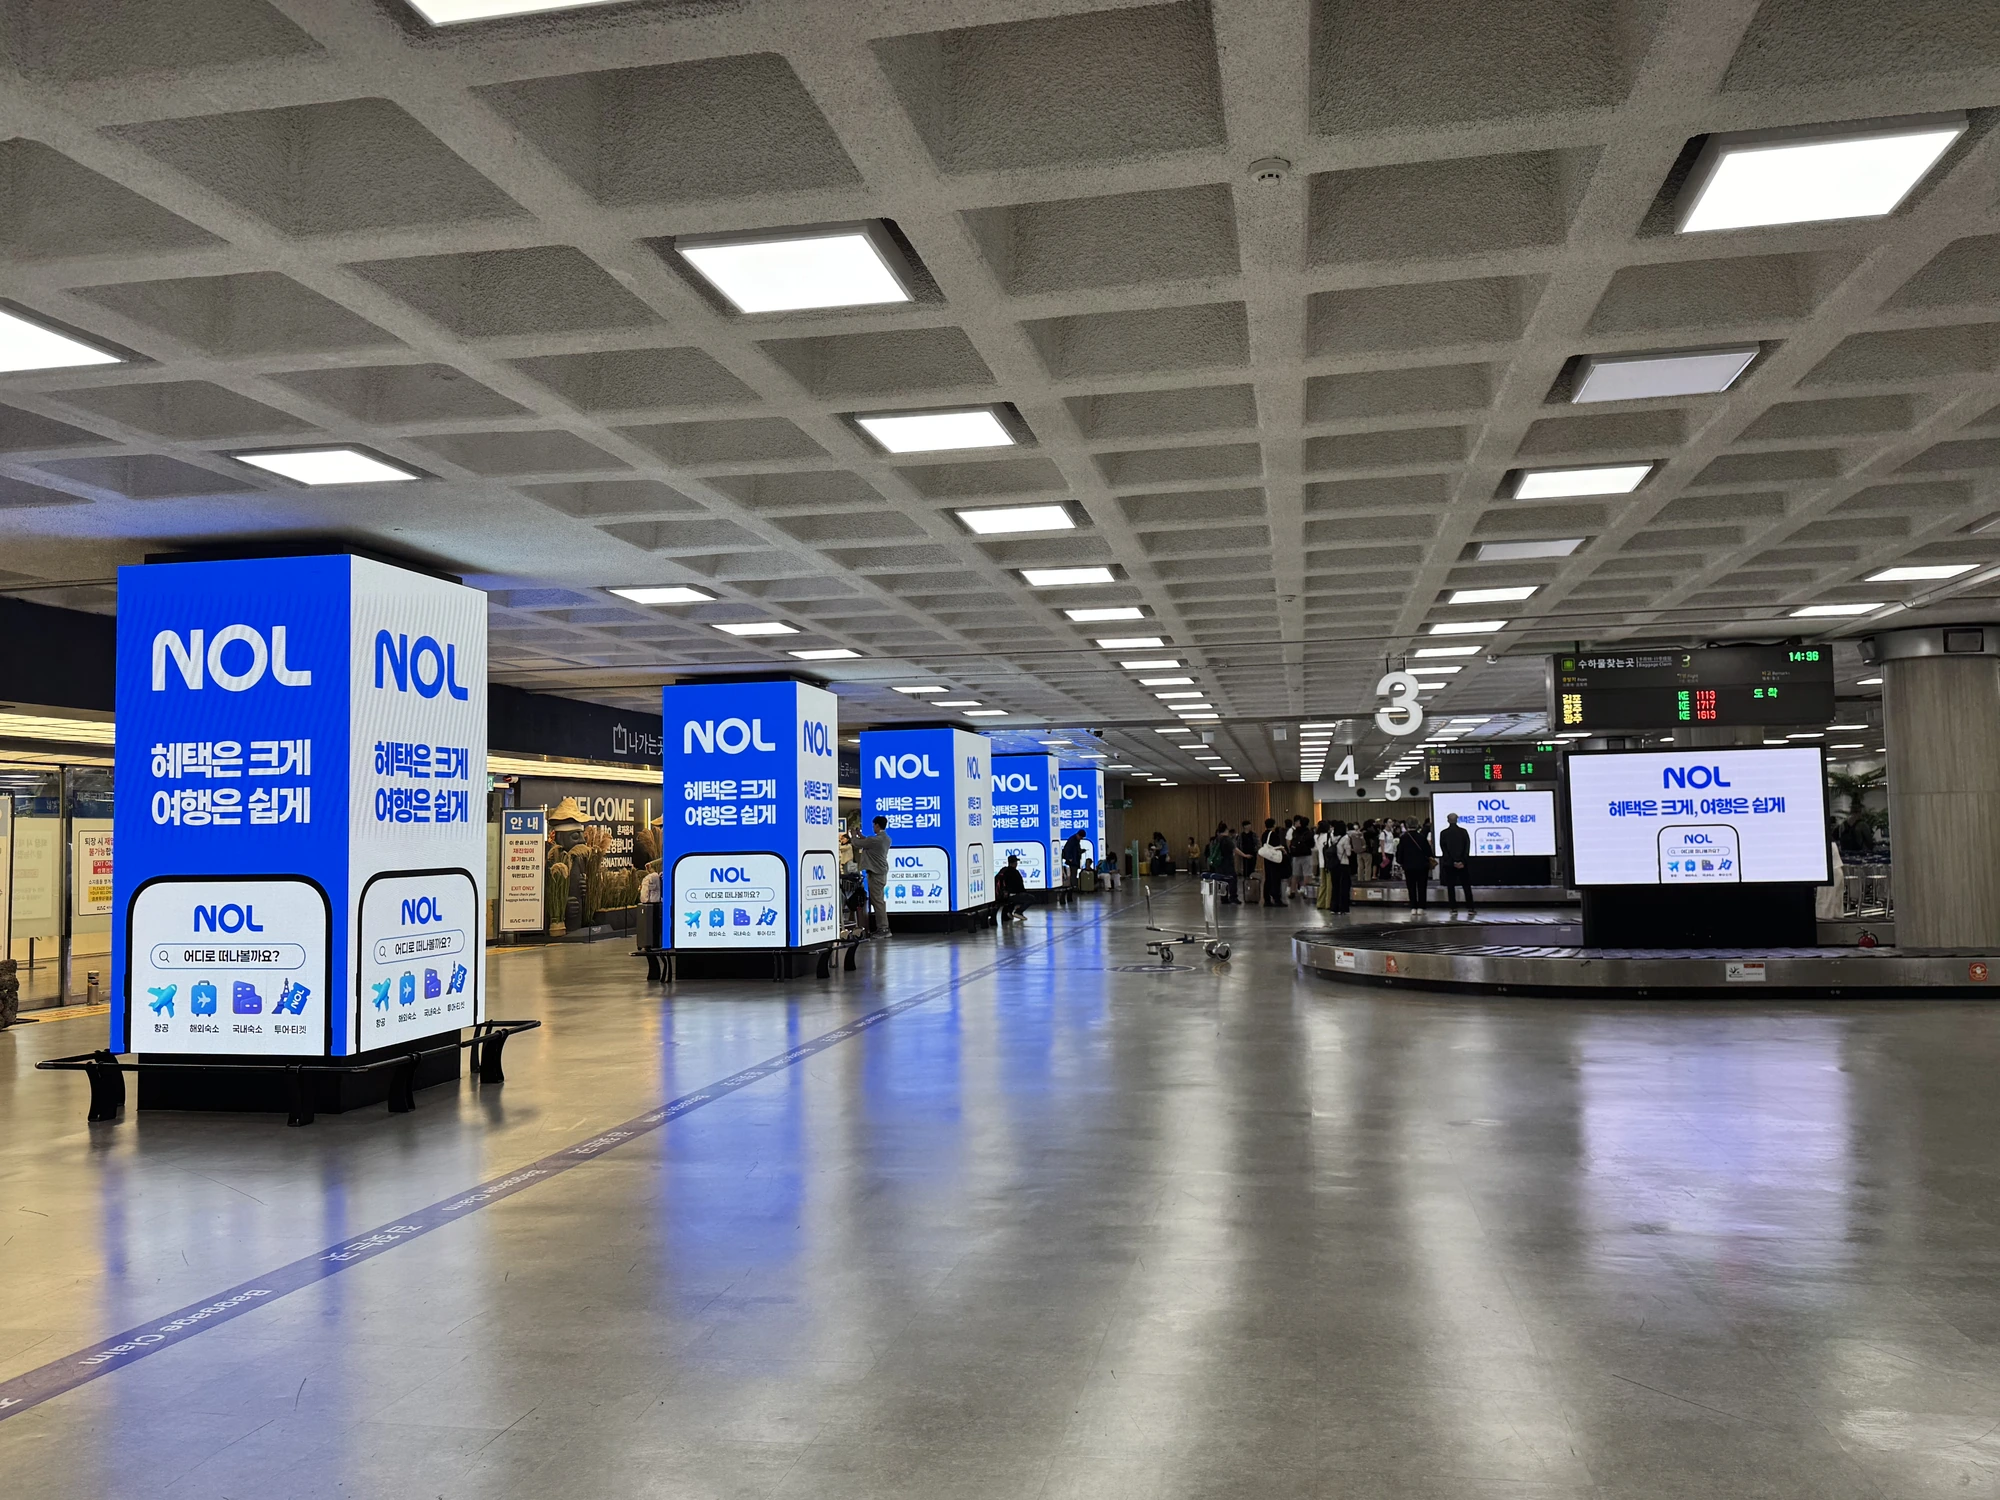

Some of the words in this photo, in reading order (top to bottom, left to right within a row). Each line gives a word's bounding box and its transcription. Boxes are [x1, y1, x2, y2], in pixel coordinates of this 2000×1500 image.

[152, 624, 312, 692] NOL
[375, 628, 468, 701] NOL
[1578, 658, 1635, 669] 수하물찾는곳
[1681, 655, 1690, 668] 3
[1375, 672, 1423, 736] 3
[1678, 691, 1689, 700] KE
[1696, 691, 1716, 700] 1113
[1678, 701, 1690, 710] KE
[1696, 701, 1715, 709] 1717
[1679, 711, 1690, 720] KE
[1697, 710, 1716, 720] 1613
[684, 718, 776, 754] NOL
[804, 720, 832, 757] NOL
[151, 740, 243, 779] 혜택은
[248, 739, 311, 776] 크게
[374, 740, 432, 778] 혜택은
[434, 746, 468, 780] 크게
[875, 753, 939, 779] NOL
[1334, 754, 1359, 787] 4
[1663, 765, 1730, 789] NOL
[684, 780, 737, 800] 혜택은
[740, 779, 776, 799] 크게
[804, 780, 821, 800] 혜택은
[822, 782, 832, 801] 크게
[992, 773, 1038, 792] NOL
[1059, 784, 1088, 800] OL
[1385, 778, 1402, 801] 5
[152, 788, 242, 826] 여행은
[248, 787, 310, 824] 쉽게
[375, 788, 431, 823] 여행은
[434, 788, 468, 823] 쉽게
[563, 796, 634, 822] ELCOME
[876, 797, 913, 811] 혜택은
[915, 796, 940, 810] 크게
[1020, 804, 1038, 815] 크게
[1478, 799, 1510, 810] NOL
[1608, 801, 1657, 817] 혜택은
[1661, 799, 1698, 818] 크게,
[1700, 798, 1749, 815] 여행은
[1752, 797, 1785, 814] 쉽게
[685, 805, 737, 826] 여행은
[741, 804, 776, 825] 쉽게
[804, 805, 821, 825] 여행은
[822, 806, 832, 825] 쉽게
[884, 814, 913, 828] 행은
[916, 814, 940, 828] 쉽게
[992, 817, 1019, 828] 여행은
[1020, 817, 1039, 828] 쉽게
[1073, 810, 1088, 818] 크게
[1458, 815, 1475, 823] 택은
[1495, 815, 1518, 823] 여행은
[1520, 815, 1536, 823] 쉽게
[1684, 834, 1712, 844] NOL
[895, 857, 923, 867] NOL
[710, 867, 750, 883] NOL
[194, 904, 263, 934] NOL
[402, 896, 442, 925] NOL
[184, 950, 216, 962] 어디로
[218, 950, 280, 962] 떠나볼까요?
[394, 942, 414, 955] 어디로
[416, 937, 451, 952] 떠나볼까요?
[290, 989, 305, 1009] NOL
[154, 1024, 169, 1033] 항공
[190, 1024, 220, 1033] 해외숙소
[232, 1024, 263, 1034] 국내숙소
[484, 1170, 548, 1193] Baggage
[442, 1194, 490, 1211] Claim
[160, 1289, 272, 1333] Baggage
[79, 1334, 164, 1366] Claim
